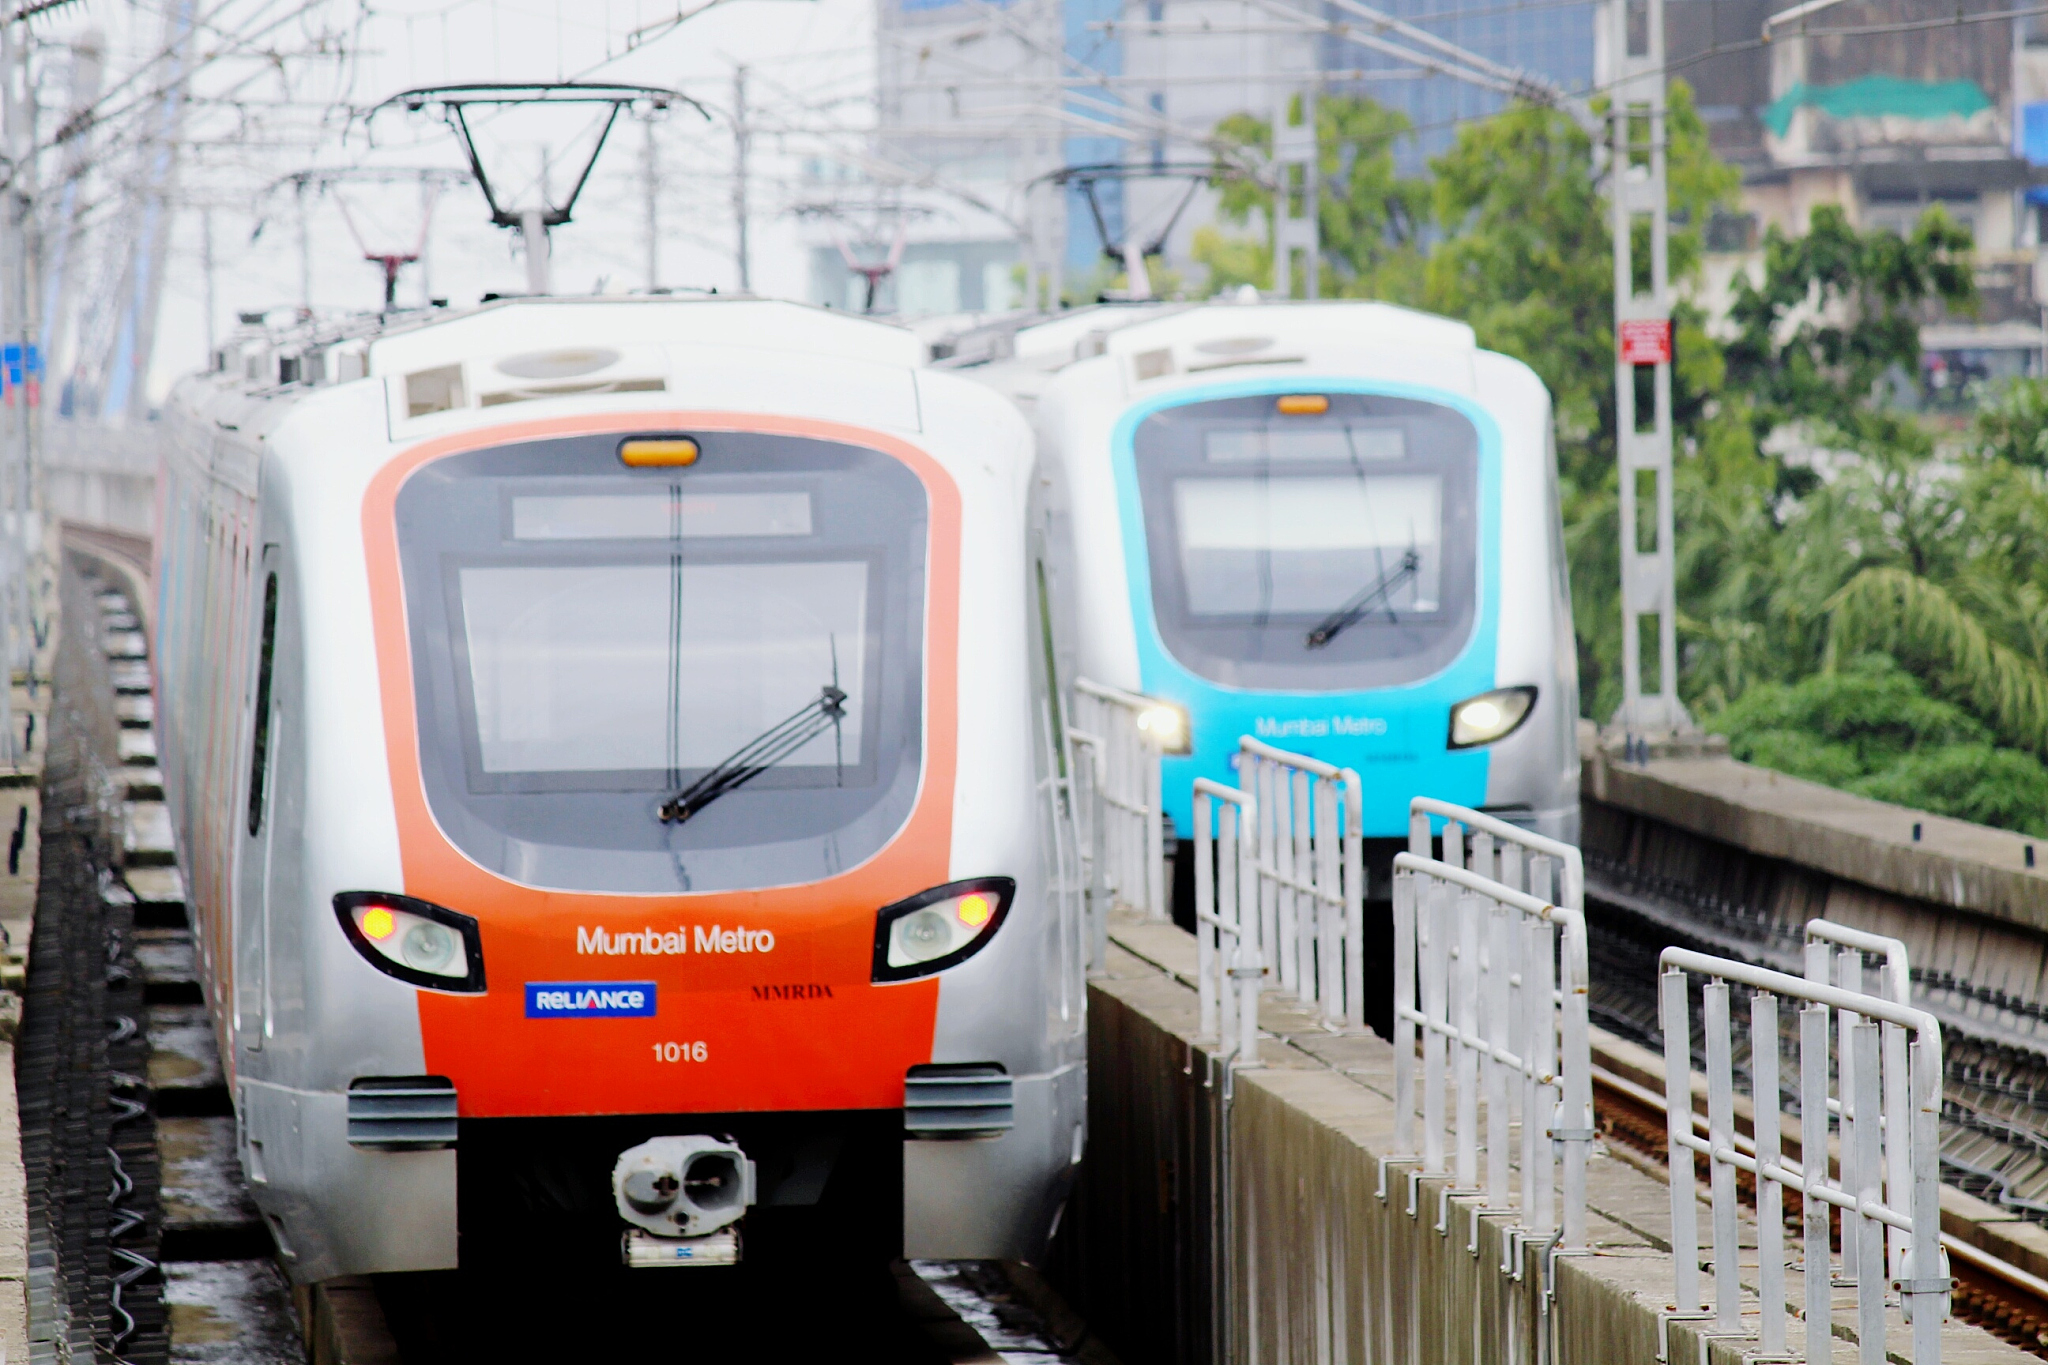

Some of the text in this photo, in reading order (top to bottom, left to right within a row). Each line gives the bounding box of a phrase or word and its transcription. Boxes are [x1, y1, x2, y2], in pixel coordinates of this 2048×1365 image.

[1255, 716, 1387, 737] Mumbai Metro
[576, 925, 775, 955] Mumbai Metro
[751, 984, 834, 1001] MMRDA
[651, 1041, 708, 1062] 1016
